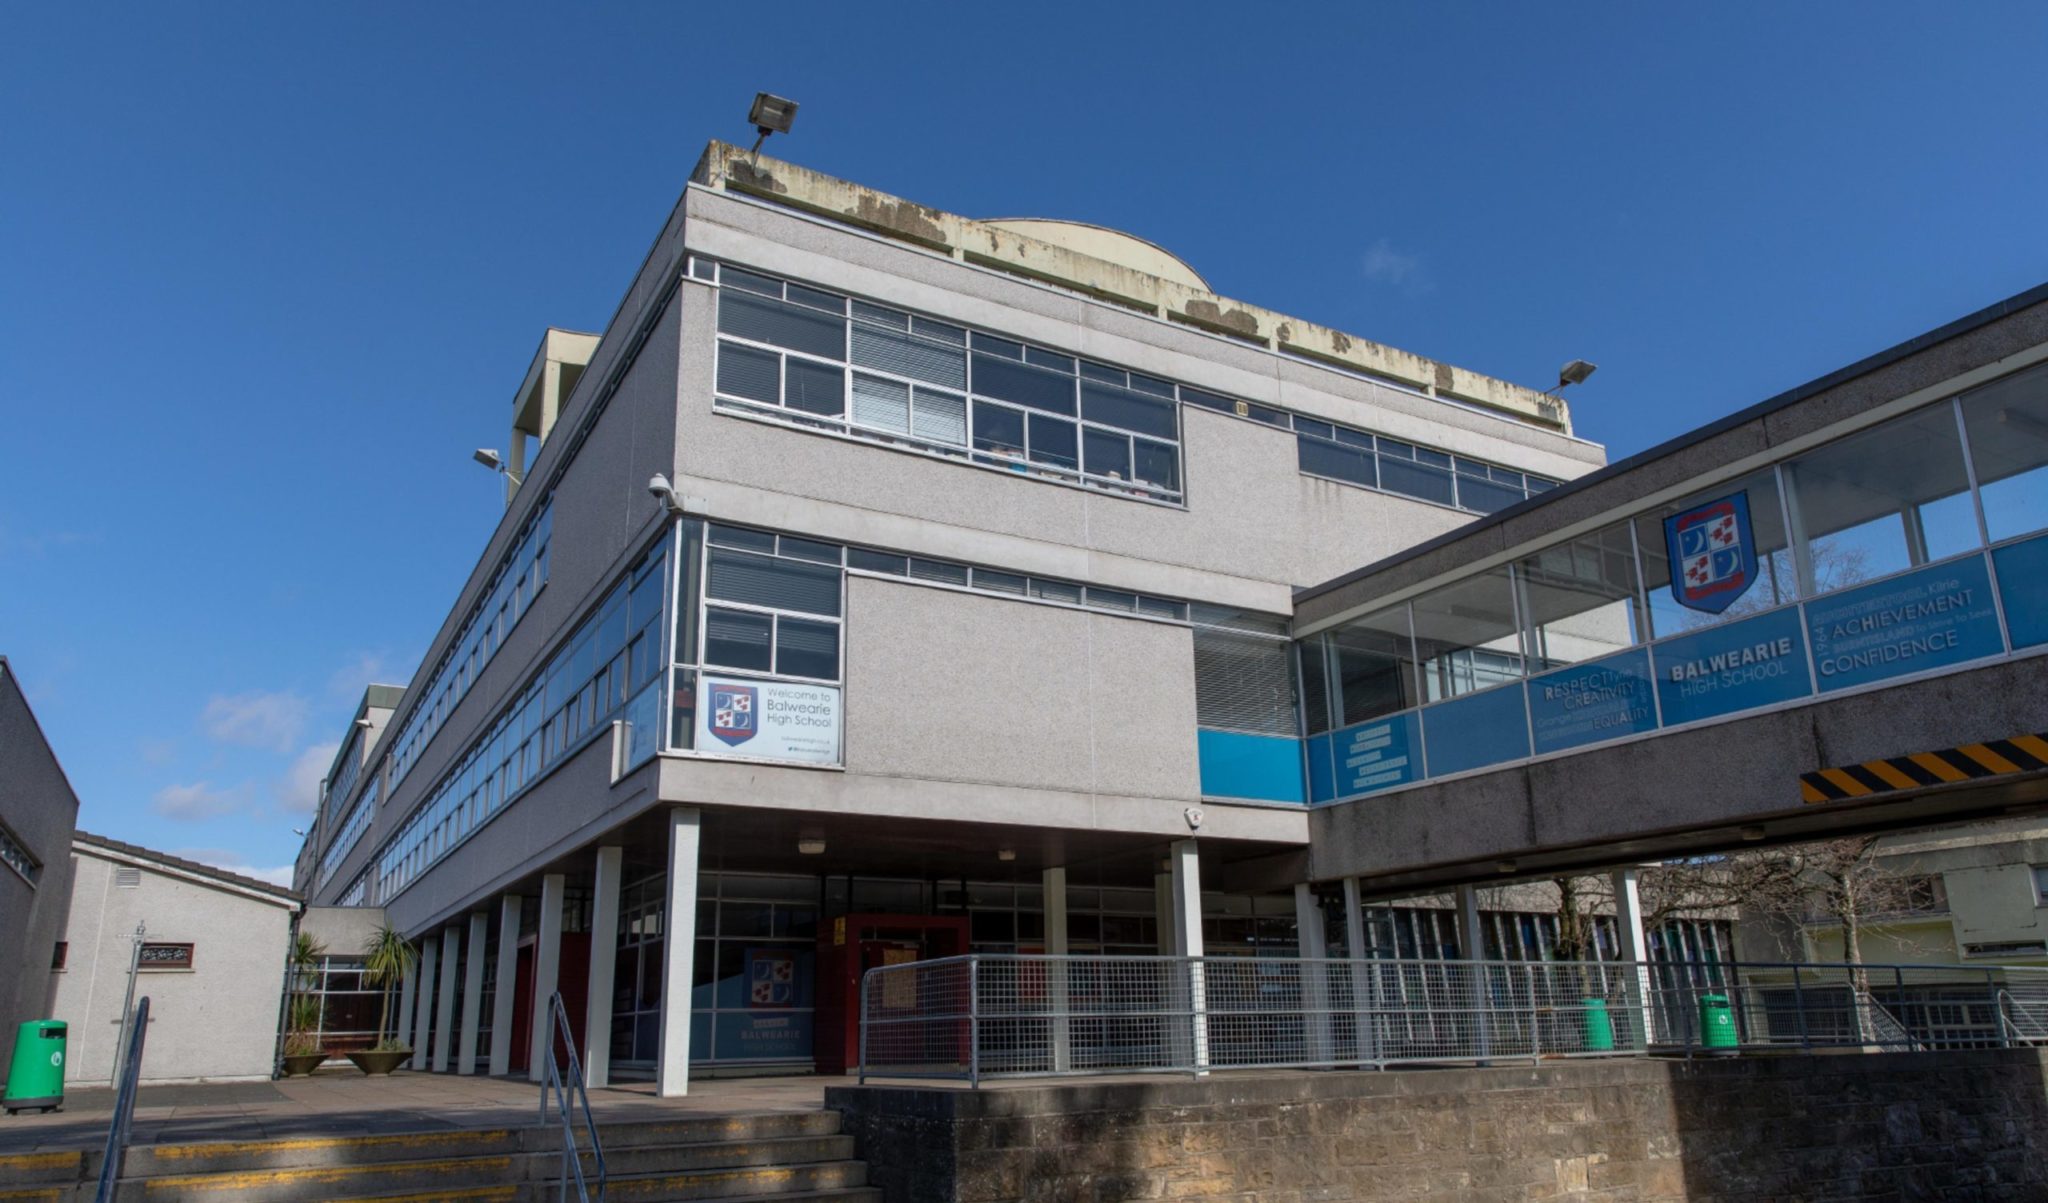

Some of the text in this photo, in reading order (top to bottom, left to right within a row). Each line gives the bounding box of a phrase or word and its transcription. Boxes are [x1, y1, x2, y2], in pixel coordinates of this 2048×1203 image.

[1832, 588, 1973, 639] ACHIEVEMENT
[1671, 636, 1792, 682] BALWEARIE
[1820, 629, 1959, 676] CONFIDENCE
[1545, 671, 1608, 701] RESPECT
[1680, 660, 1789, 698] HIGH SCHOOL
[767, 688, 831, 702] Welcome to
[767, 699, 831, 715] Balwearie
[1564, 681, 1634, 710] CREATIVITY
[767, 713, 831, 728] High School
[1593, 706, 1649, 730] EQUALITY
